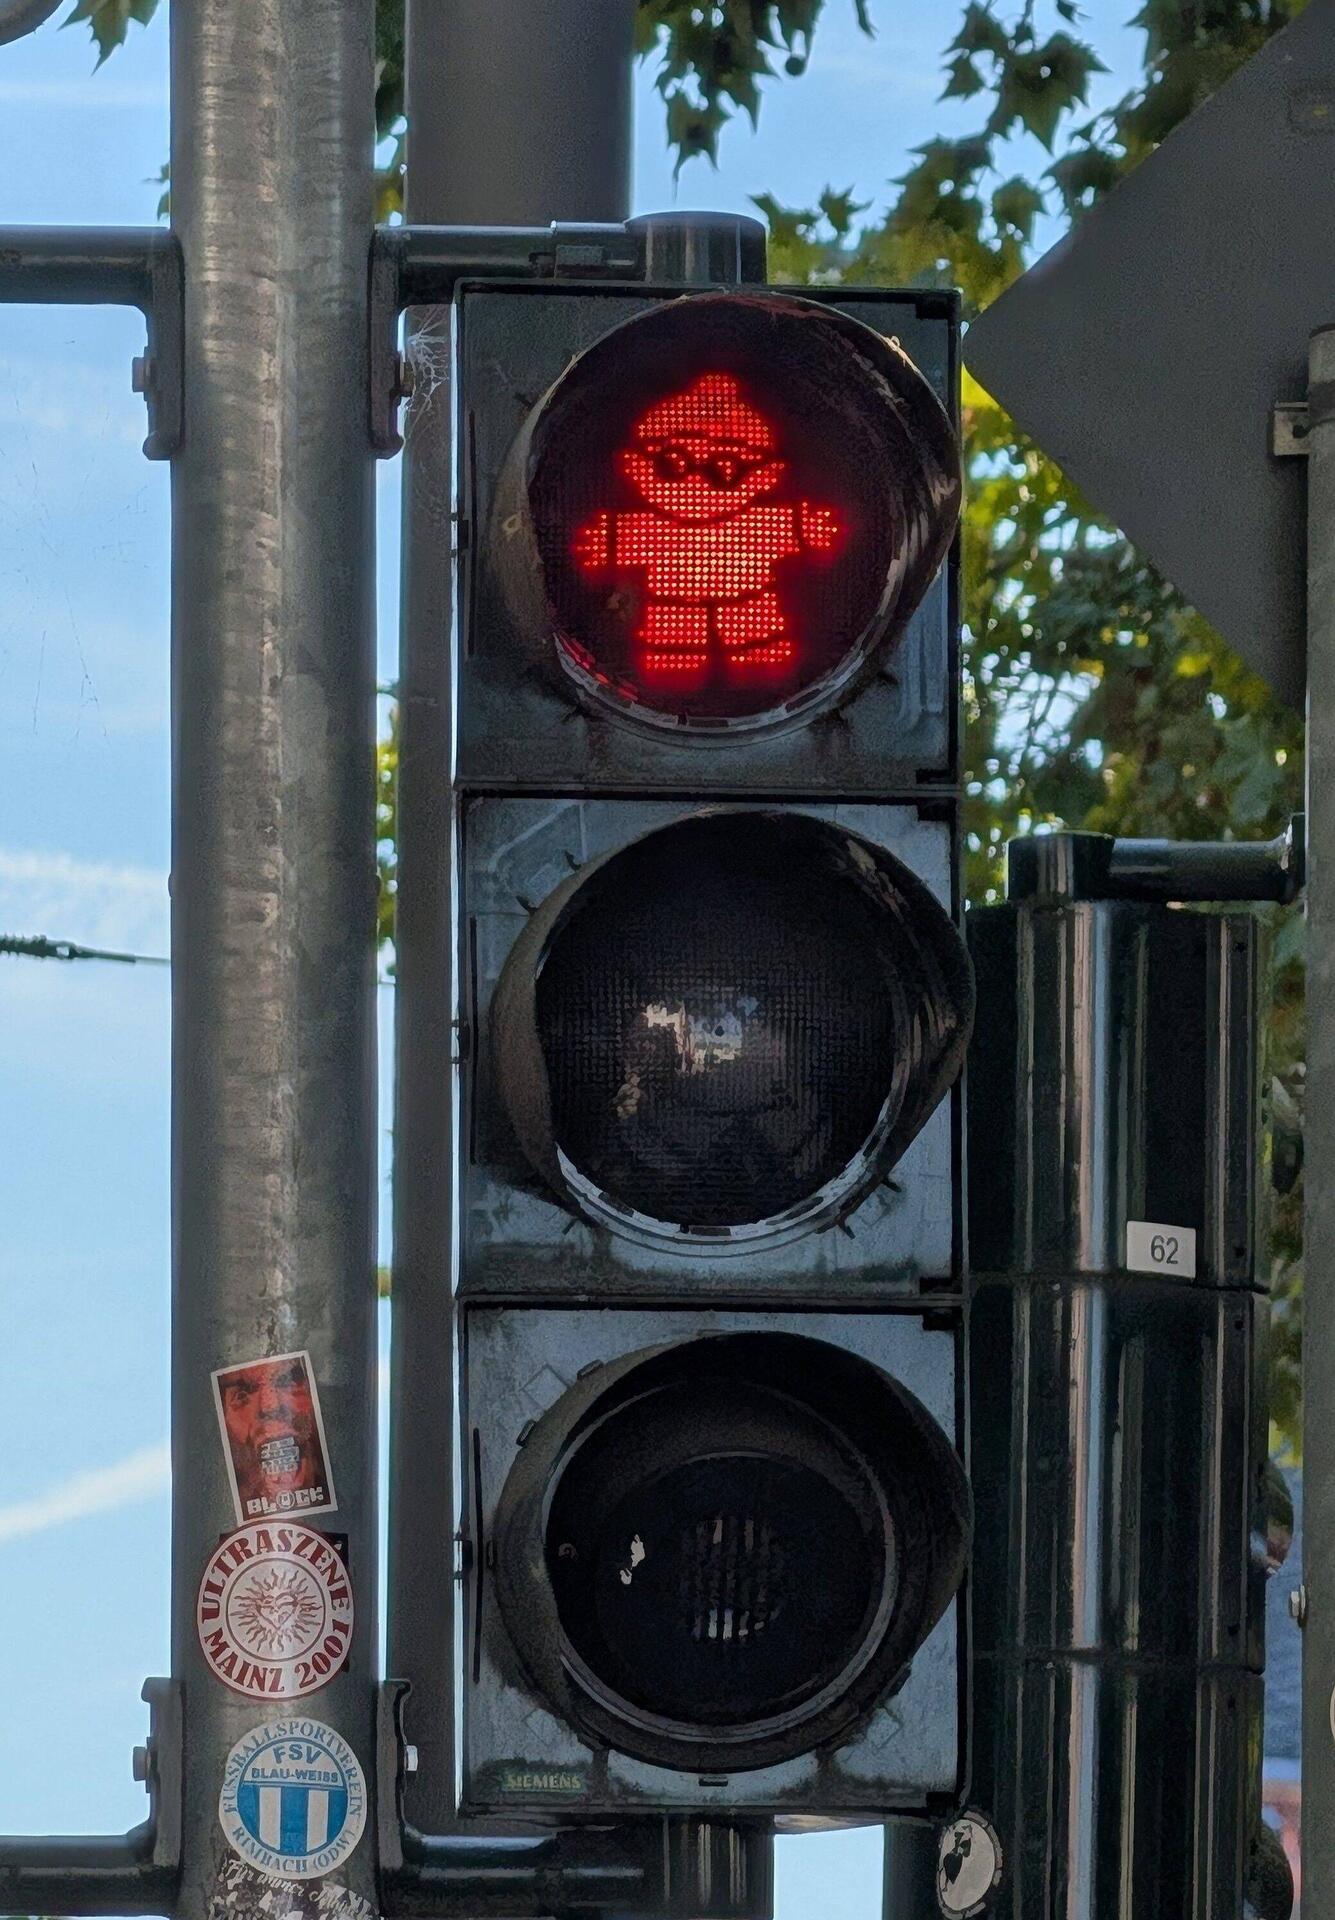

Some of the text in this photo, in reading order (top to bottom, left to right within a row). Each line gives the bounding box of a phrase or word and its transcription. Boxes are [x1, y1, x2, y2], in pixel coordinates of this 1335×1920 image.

[1151, 1235, 1178, 1264] 62
[201, 1529, 349, 1624] ULTRASZENE
[204, 1619, 350, 1692] MAINZ 2001
[223, 1722, 362, 1817] FUSSBALLSPORTVEREIN
[273, 1743, 323, 1764] FSV
[251, 1767, 339, 1782] BLAU-WEISS
[507, 1773, 580, 1788] SIEMENS
[232, 1825, 308, 1873] RIMBACH
